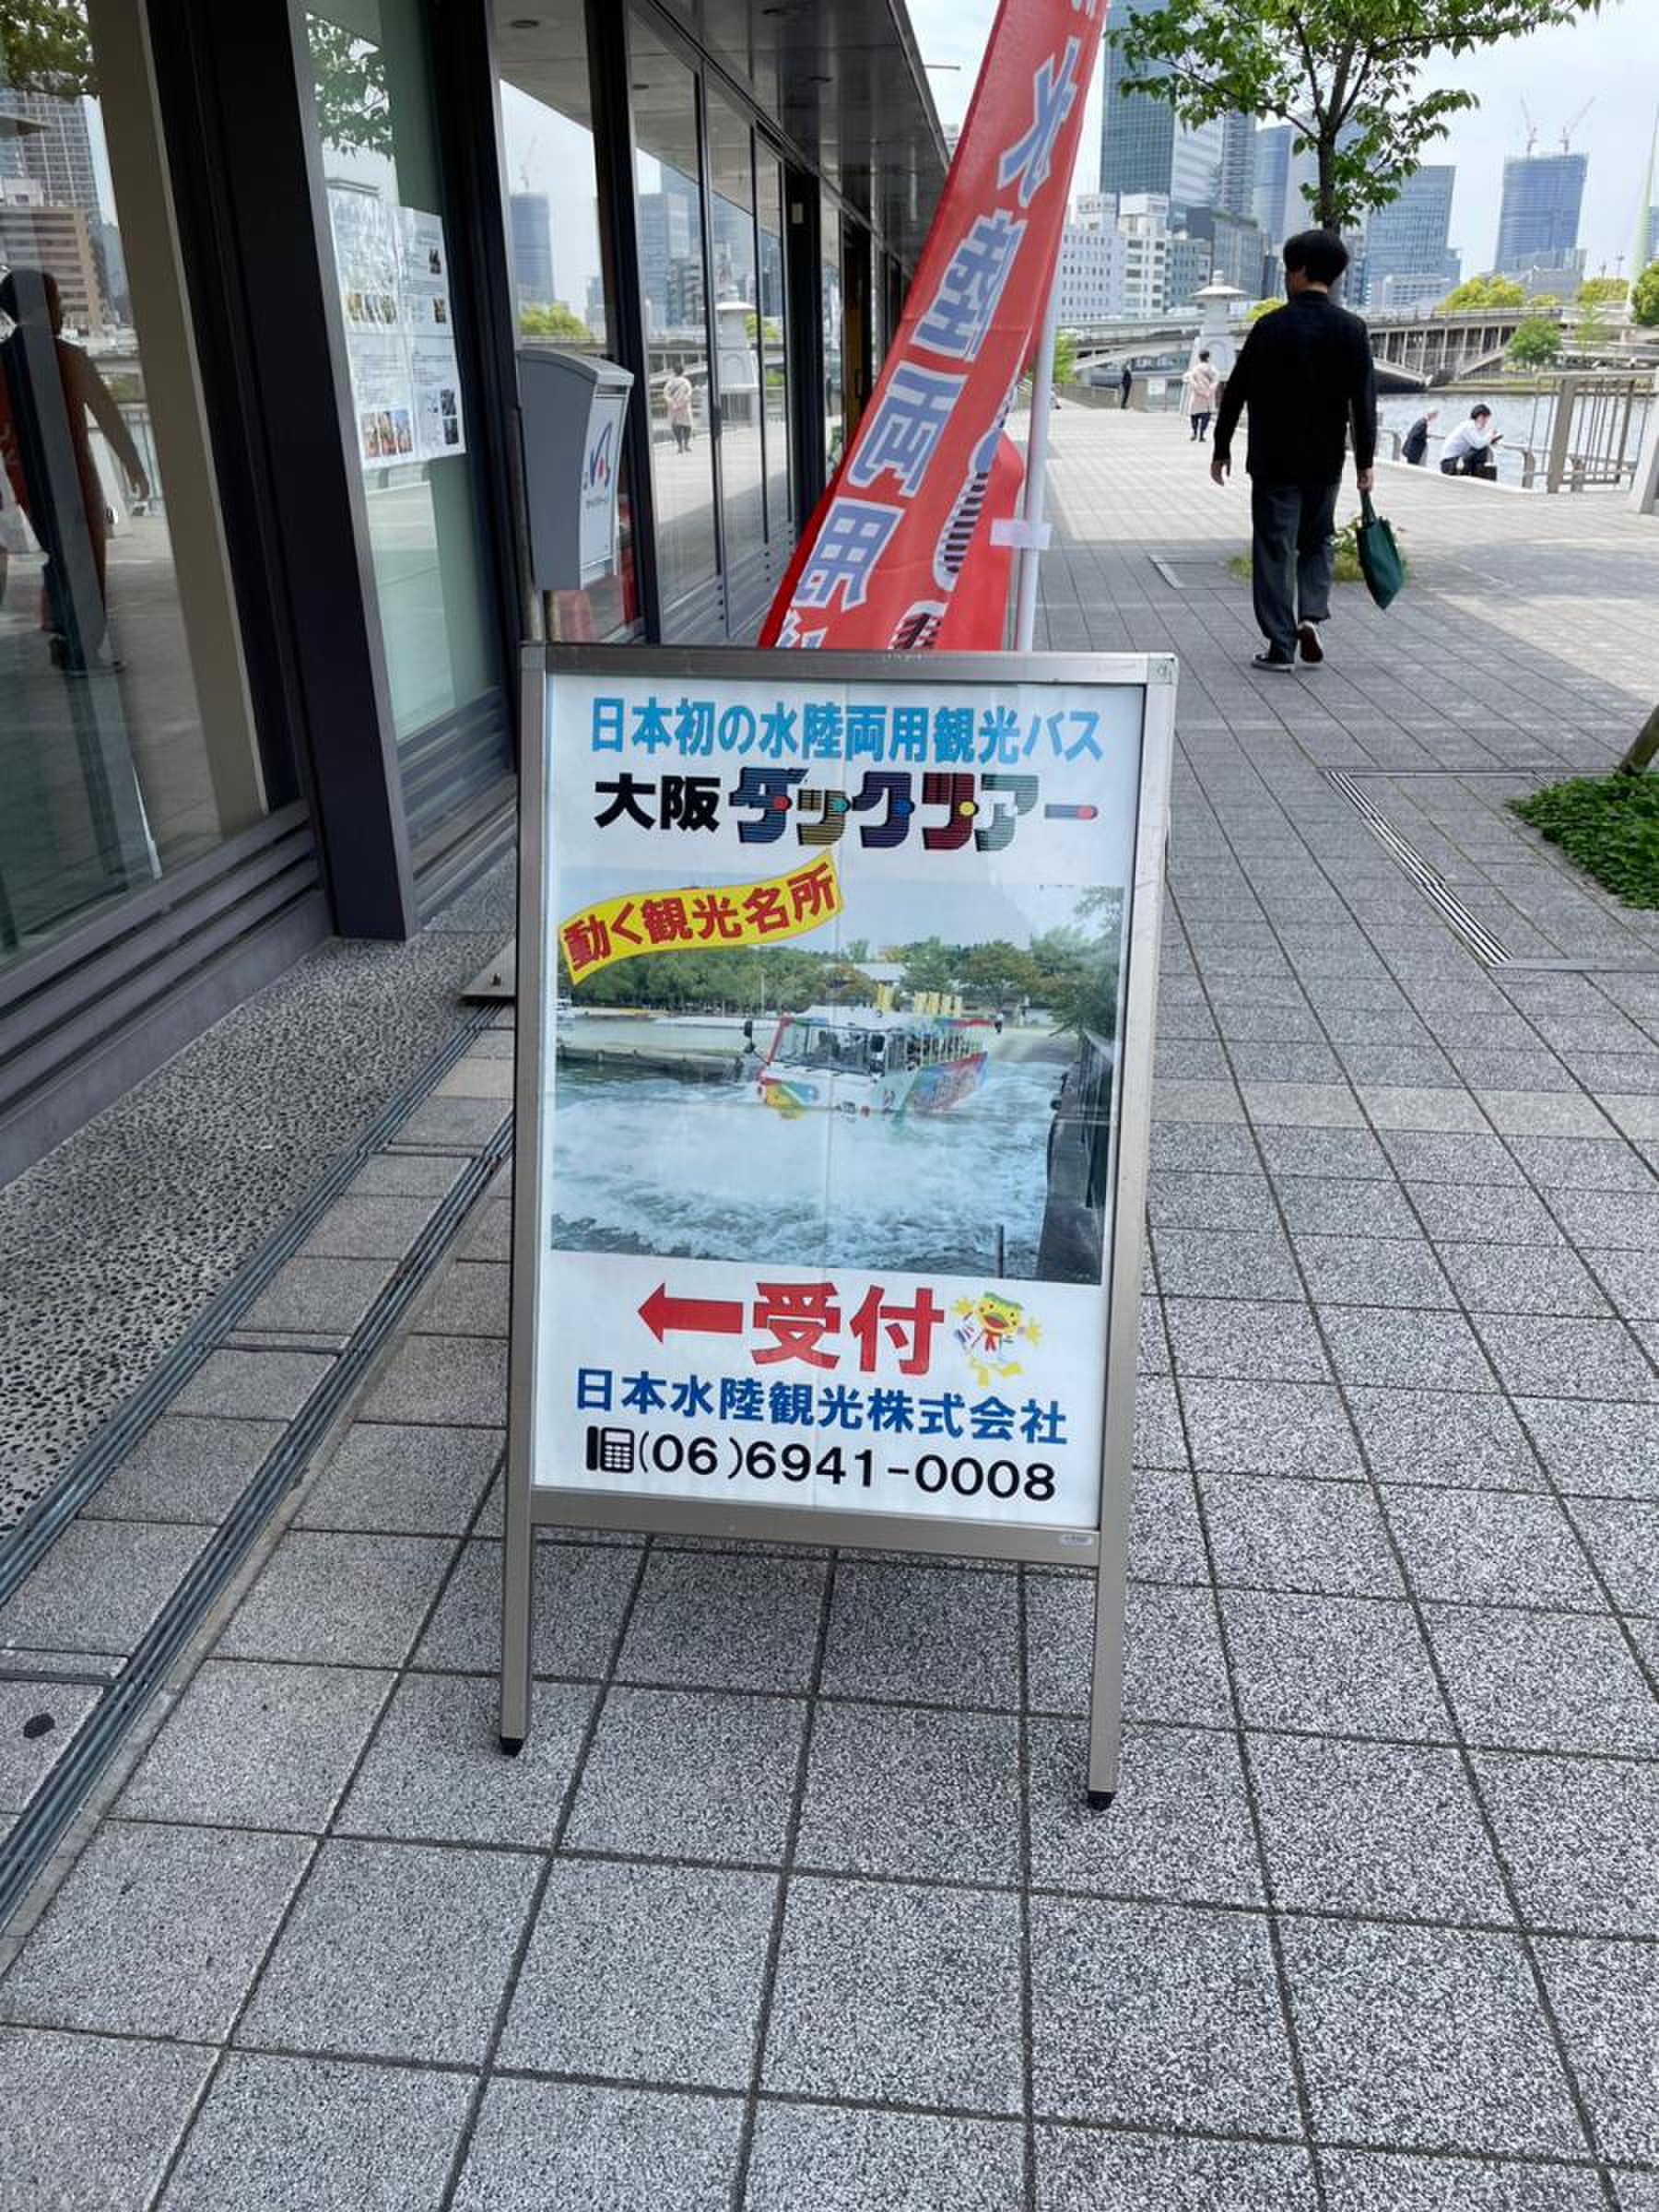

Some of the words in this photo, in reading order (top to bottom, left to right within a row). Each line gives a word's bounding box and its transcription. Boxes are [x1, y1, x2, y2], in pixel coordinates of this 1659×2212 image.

[591, 696, 1104, 764] 日本初の水陸両用観光バス
[594, 767, 1098, 852] 大阪ダックツアー
[562, 862, 839, 971] 動く観光名所
[750, 1282, 945, 1375] 受付
[576, 1368, 1068, 1444] 日本水陸観光株式会社
[638, 1430, 1056, 1501] (06)6941-0008
